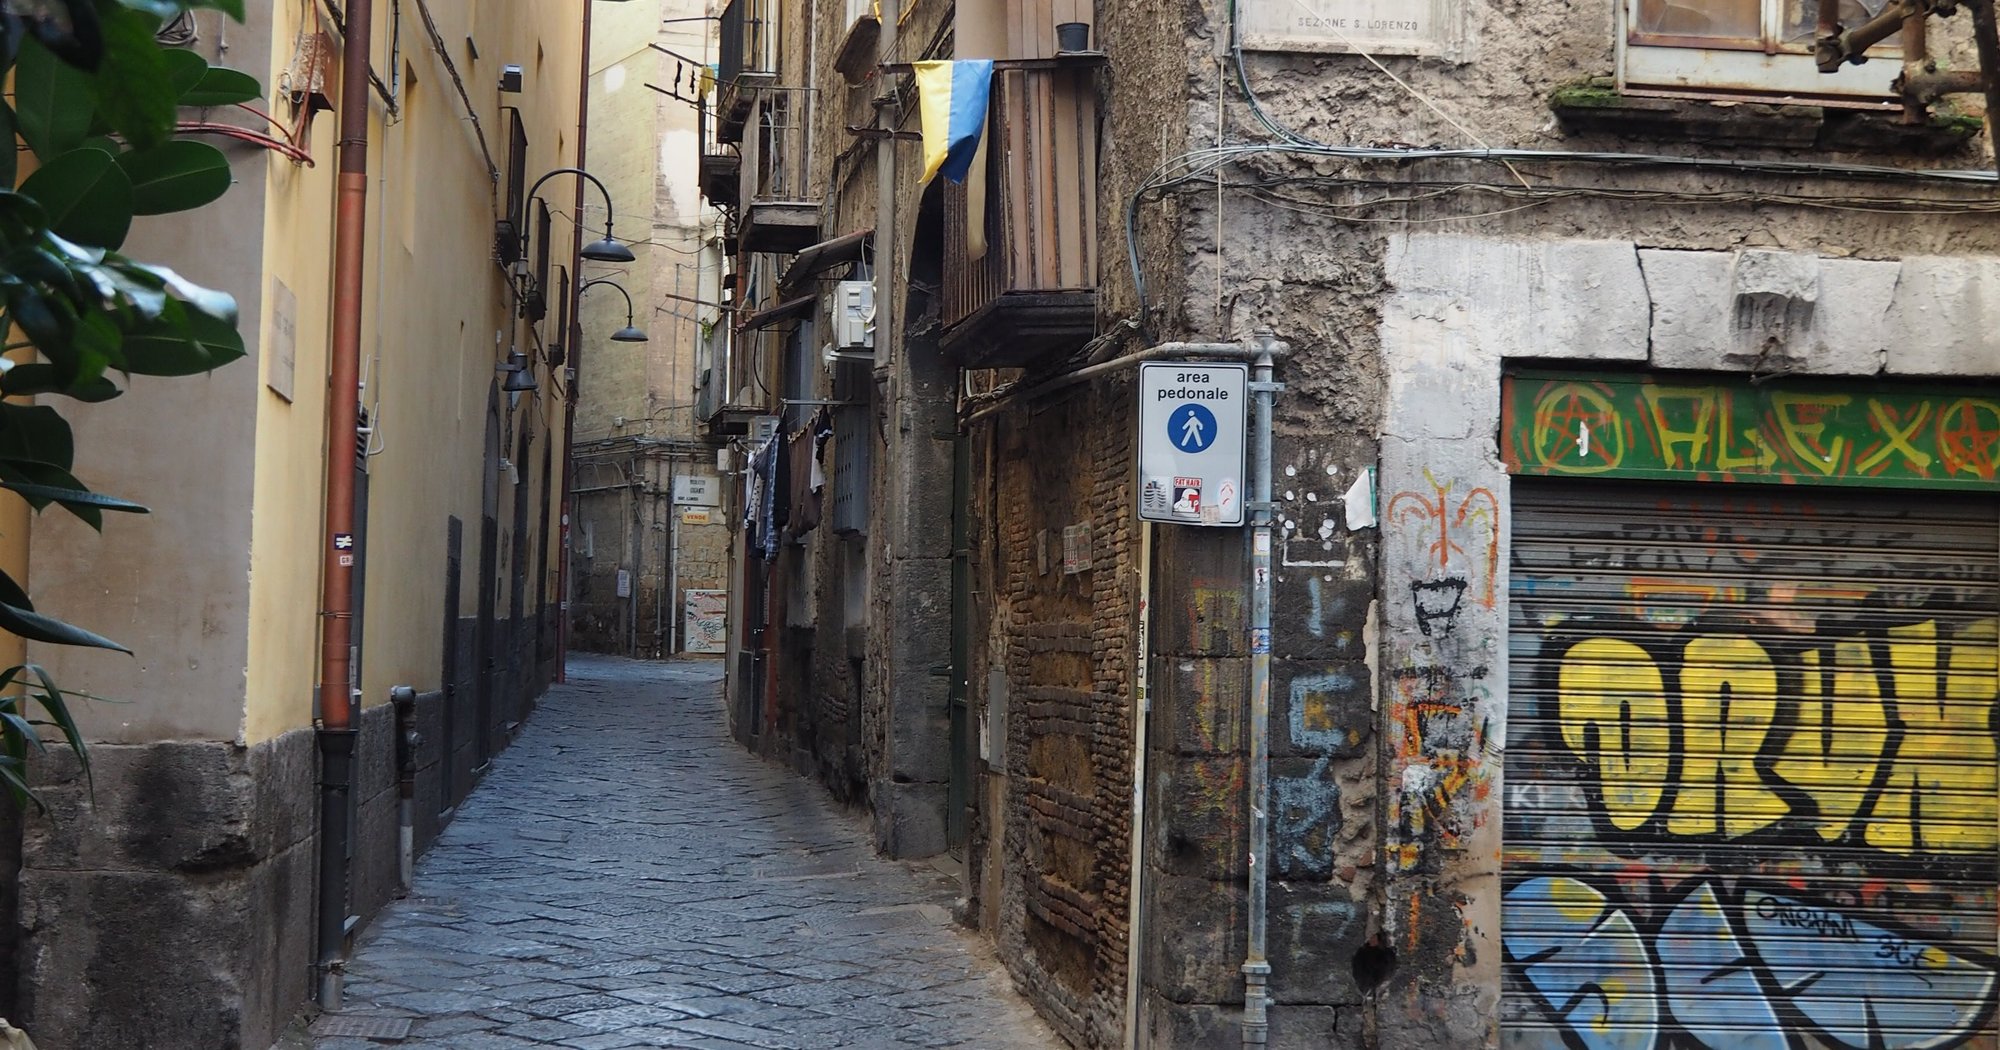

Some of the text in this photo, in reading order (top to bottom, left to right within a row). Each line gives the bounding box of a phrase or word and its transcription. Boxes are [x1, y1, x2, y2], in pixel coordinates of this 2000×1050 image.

[1367, 20, 1418, 31] LORENZO
[1177, 373, 1210, 383] area
[1158, 387, 1228, 402] pedonale
